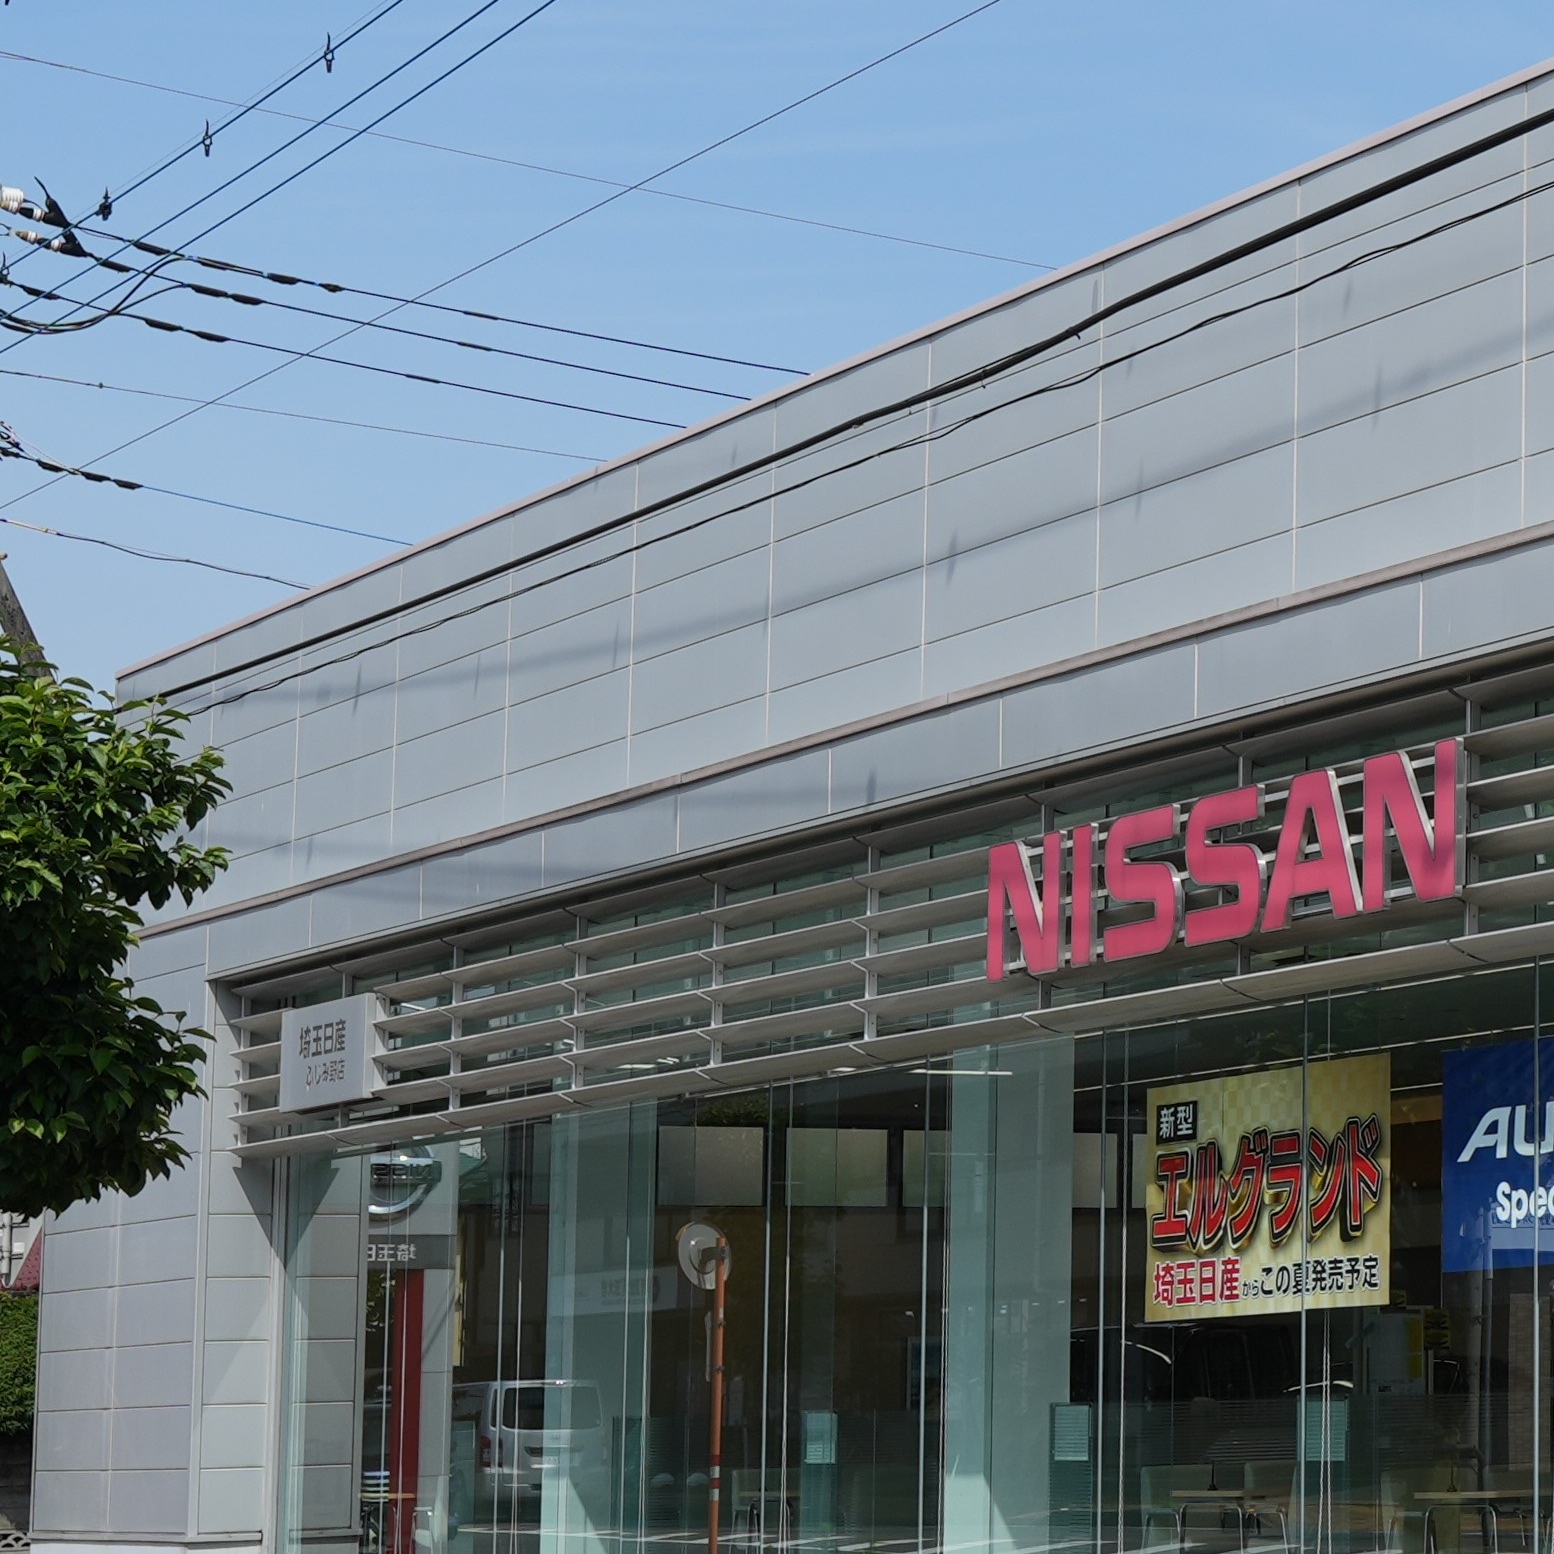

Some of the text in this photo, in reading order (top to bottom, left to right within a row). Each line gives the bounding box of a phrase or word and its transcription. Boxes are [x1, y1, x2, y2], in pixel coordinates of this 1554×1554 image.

[985, 737, 1465, 982] NISSAN
[299, 1019, 347, 1059] 埼玉日産
[306, 1058, 345, 1086] ふじみ野店
[1159, 1104, 1194, 1138] 新型
[1152, 1113, 1382, 1251] エルグランド
